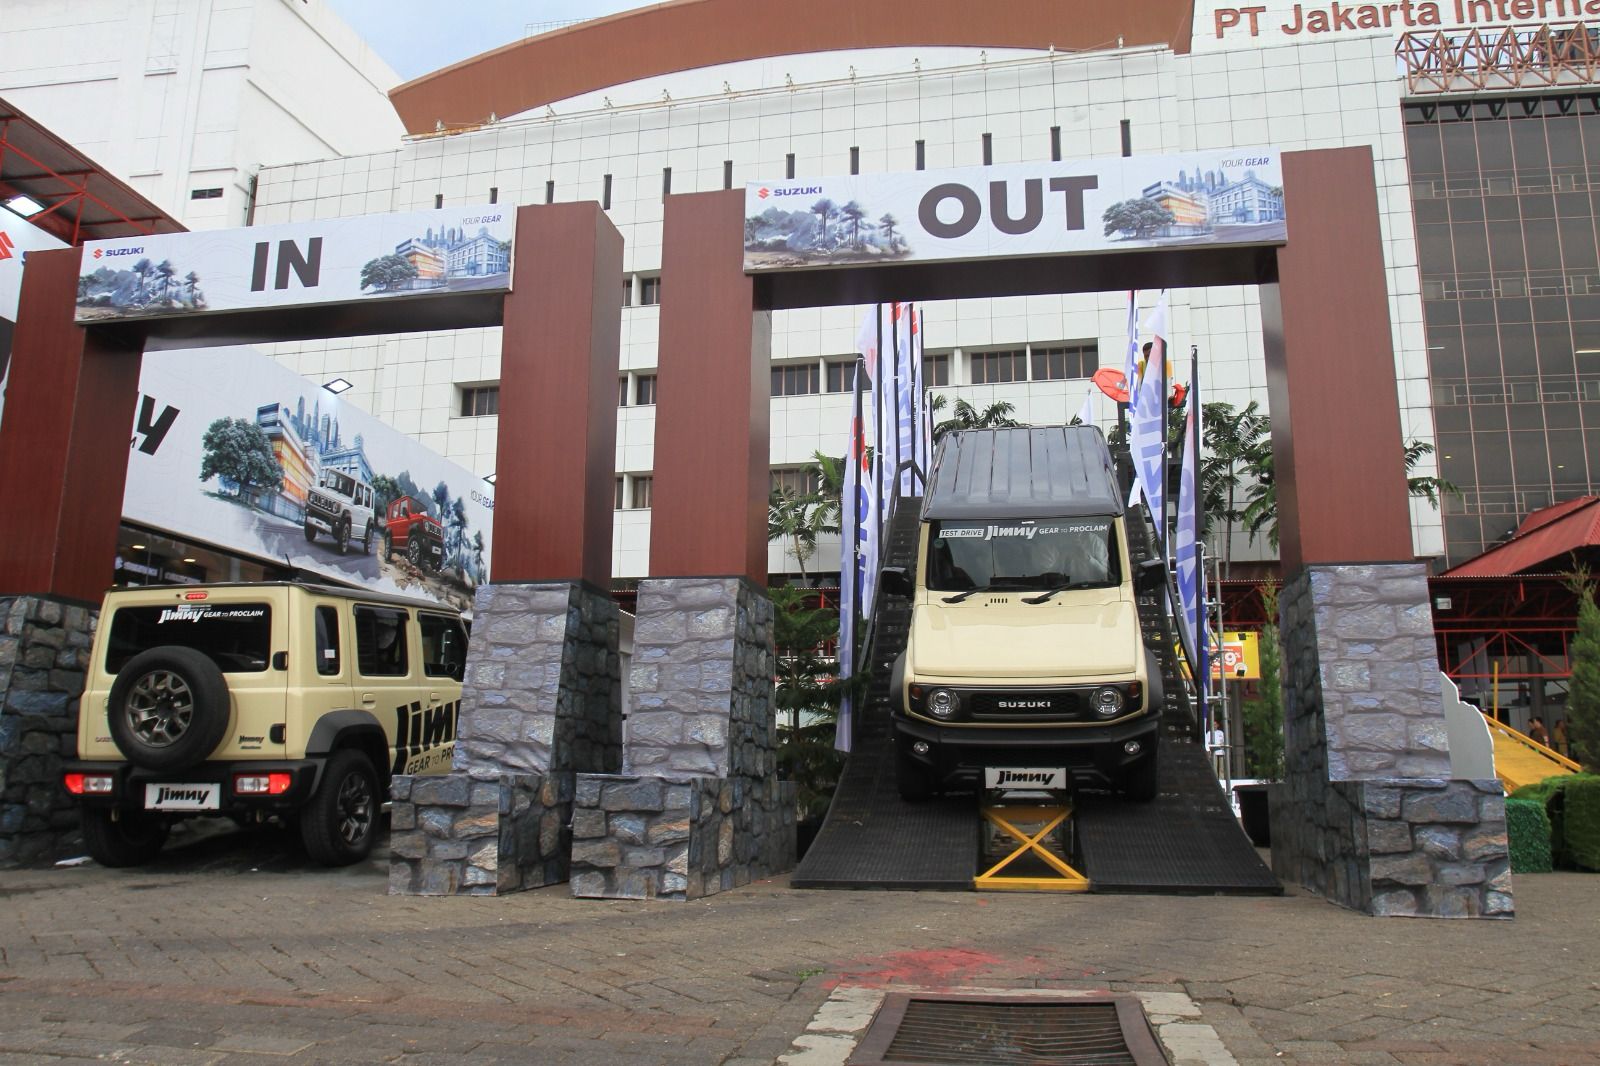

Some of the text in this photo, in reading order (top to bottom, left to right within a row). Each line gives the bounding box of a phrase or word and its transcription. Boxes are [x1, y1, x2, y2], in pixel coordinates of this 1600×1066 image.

[1215, 6, 1266, 38] PT
[1281, 1, 1442, 35] Jakarta
[1221, 157, 1270, 168] YOUR GEAR
[774, 186, 822, 197] SUZUKI
[918, 174, 1099, 239] OUT
[481, 214, 502, 224] GEAR
[106, 246, 145, 257] SUZUKI
[251, 236, 323, 292] IN
[984, 525, 1038, 540] Jimny
[1039, 527, 1059, 535] GEAR
[1069, 524, 1108, 533] PROCLAIM
[158, 610, 203, 624] Jimny
[407, 755, 431, 775] GEAR
[996, 770, 1055, 785] Jimny
[155, 787, 210, 804] Jimny
